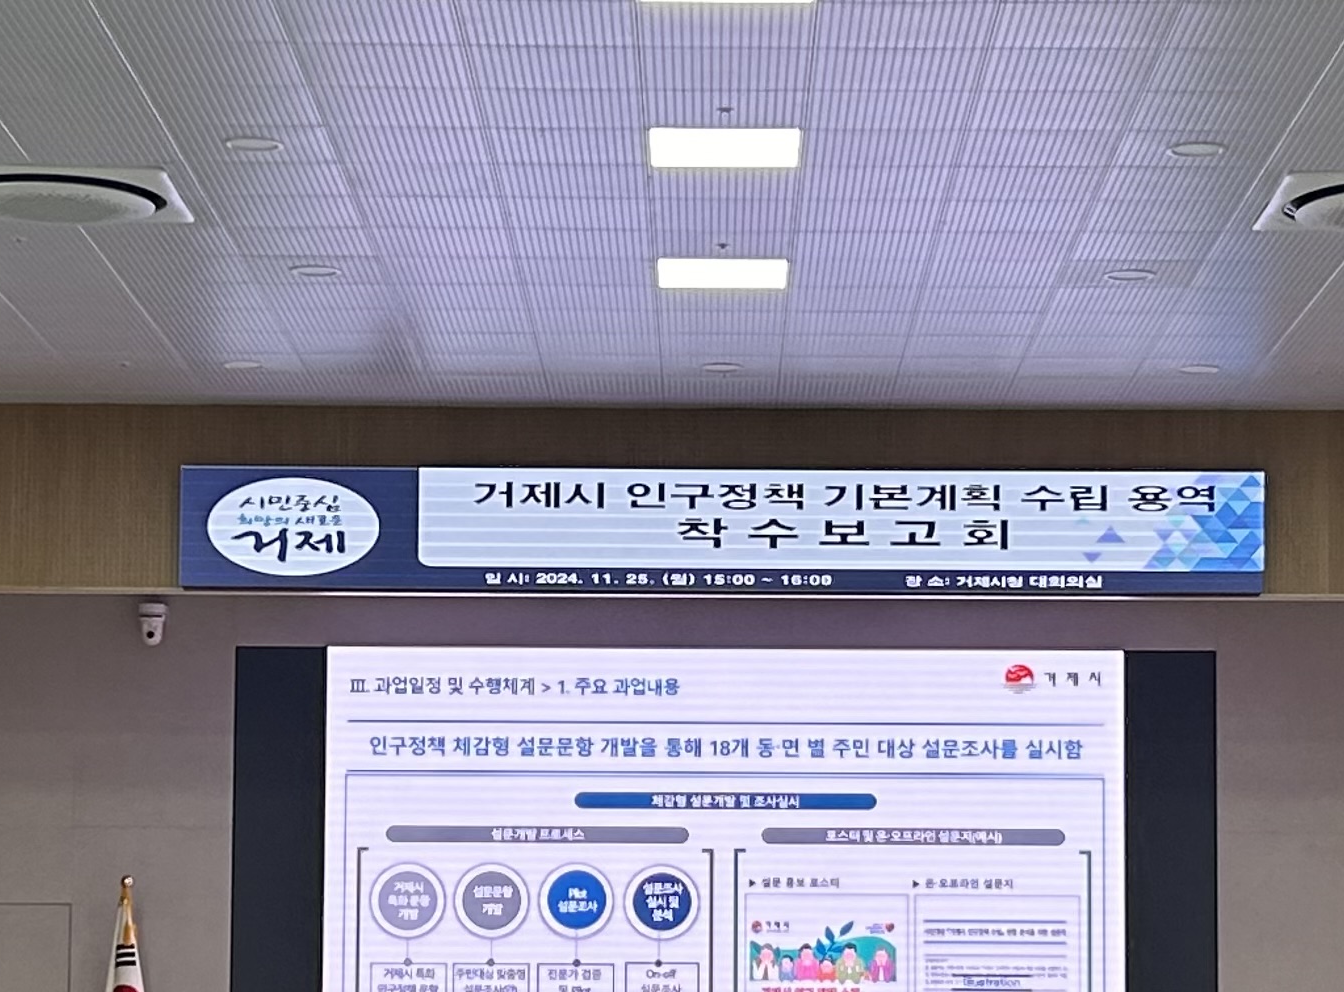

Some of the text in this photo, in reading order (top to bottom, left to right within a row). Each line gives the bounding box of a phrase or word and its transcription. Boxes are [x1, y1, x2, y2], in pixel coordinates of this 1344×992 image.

[239, 494, 342, 512] 시민중심
[473, 481, 1217, 513] 거제시 인구정책 기본계획 수립 용역
[230, 527, 346, 563] 거제
[535, 572, 584, 585] 2024.
[591, 572, 619, 585] 11.
[626, 573, 655, 586] 25.
[703, 573, 756, 586] 15:00
[956, 574, 1024, 588] 거제시청
[1029, 574, 1103, 589] 대회의실
[374, 676, 441, 695] 과업일정
[448, 676, 463, 695] 및
[468, 677, 535, 695] 수행체계
[574, 678, 608, 695] 주요
[613, 678, 680, 696] 과업내용
[370, 736, 445, 756] 인구정책
[453, 736, 509, 757] 체감형
[518, 736, 594, 757] 설문문항
[601, 737, 657, 757] 개발을
[665, 737, 702, 757] 통해
[710, 738, 749, 758] 18개
[807, 738, 825, 758] 별
[832, 738, 869, 758] 주민
[877, 738, 915, 759] 대상
[922, 738, 1018, 760] 설문조사를
[1025, 739, 1083, 760] 실시함
